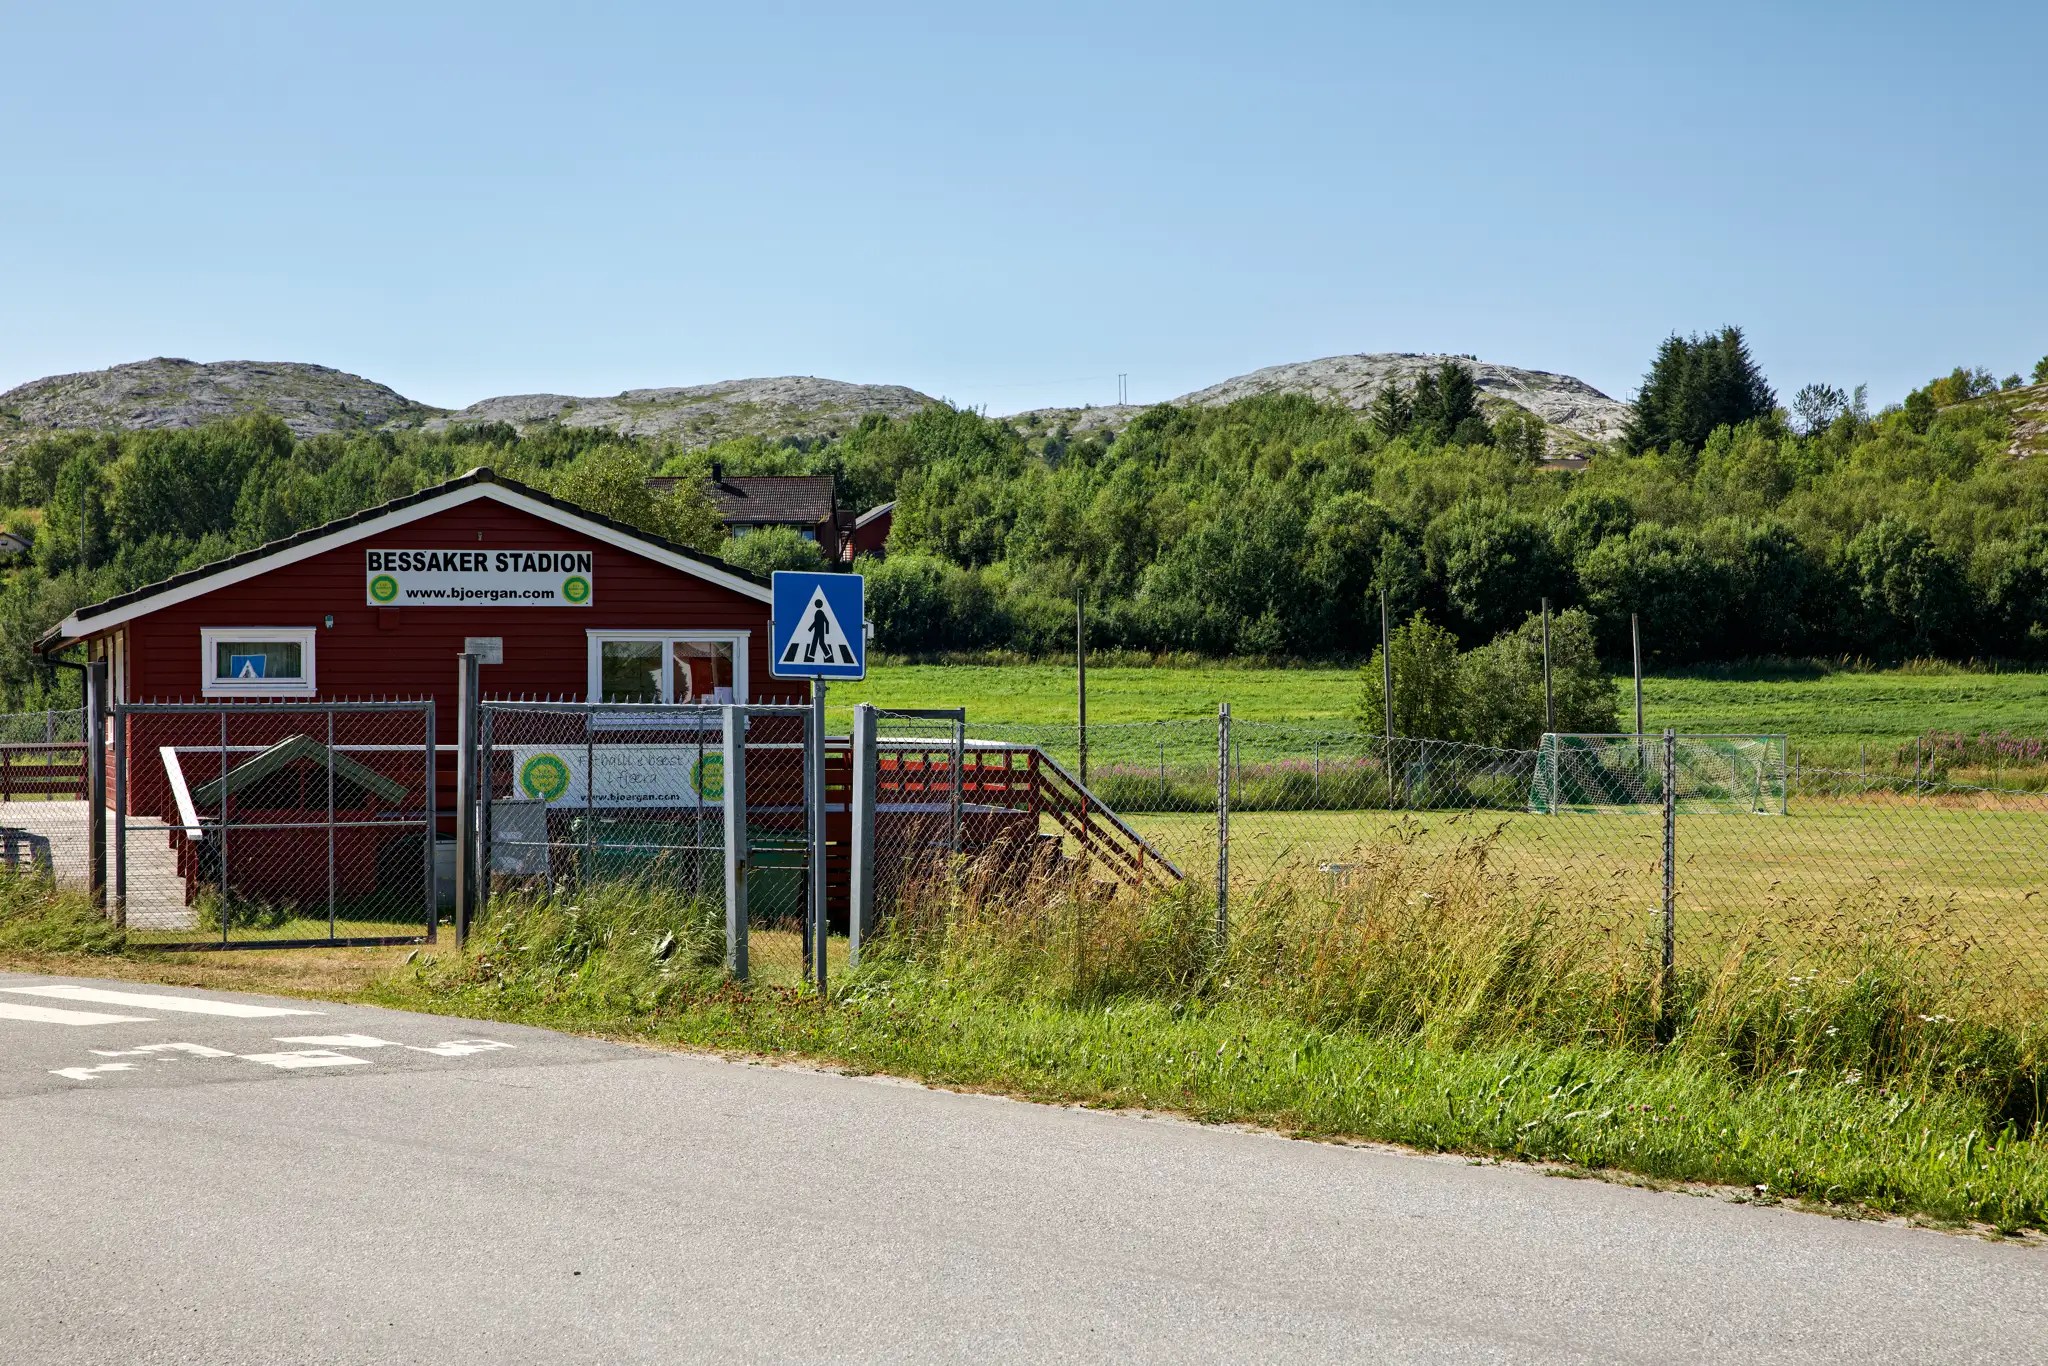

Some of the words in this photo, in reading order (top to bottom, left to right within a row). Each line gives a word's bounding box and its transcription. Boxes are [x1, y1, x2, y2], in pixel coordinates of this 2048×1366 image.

[368, 552, 489, 572] BESSAKER
[495, 552, 592, 573] STADION
[406, 587, 555, 602] www.bjoergan.com
